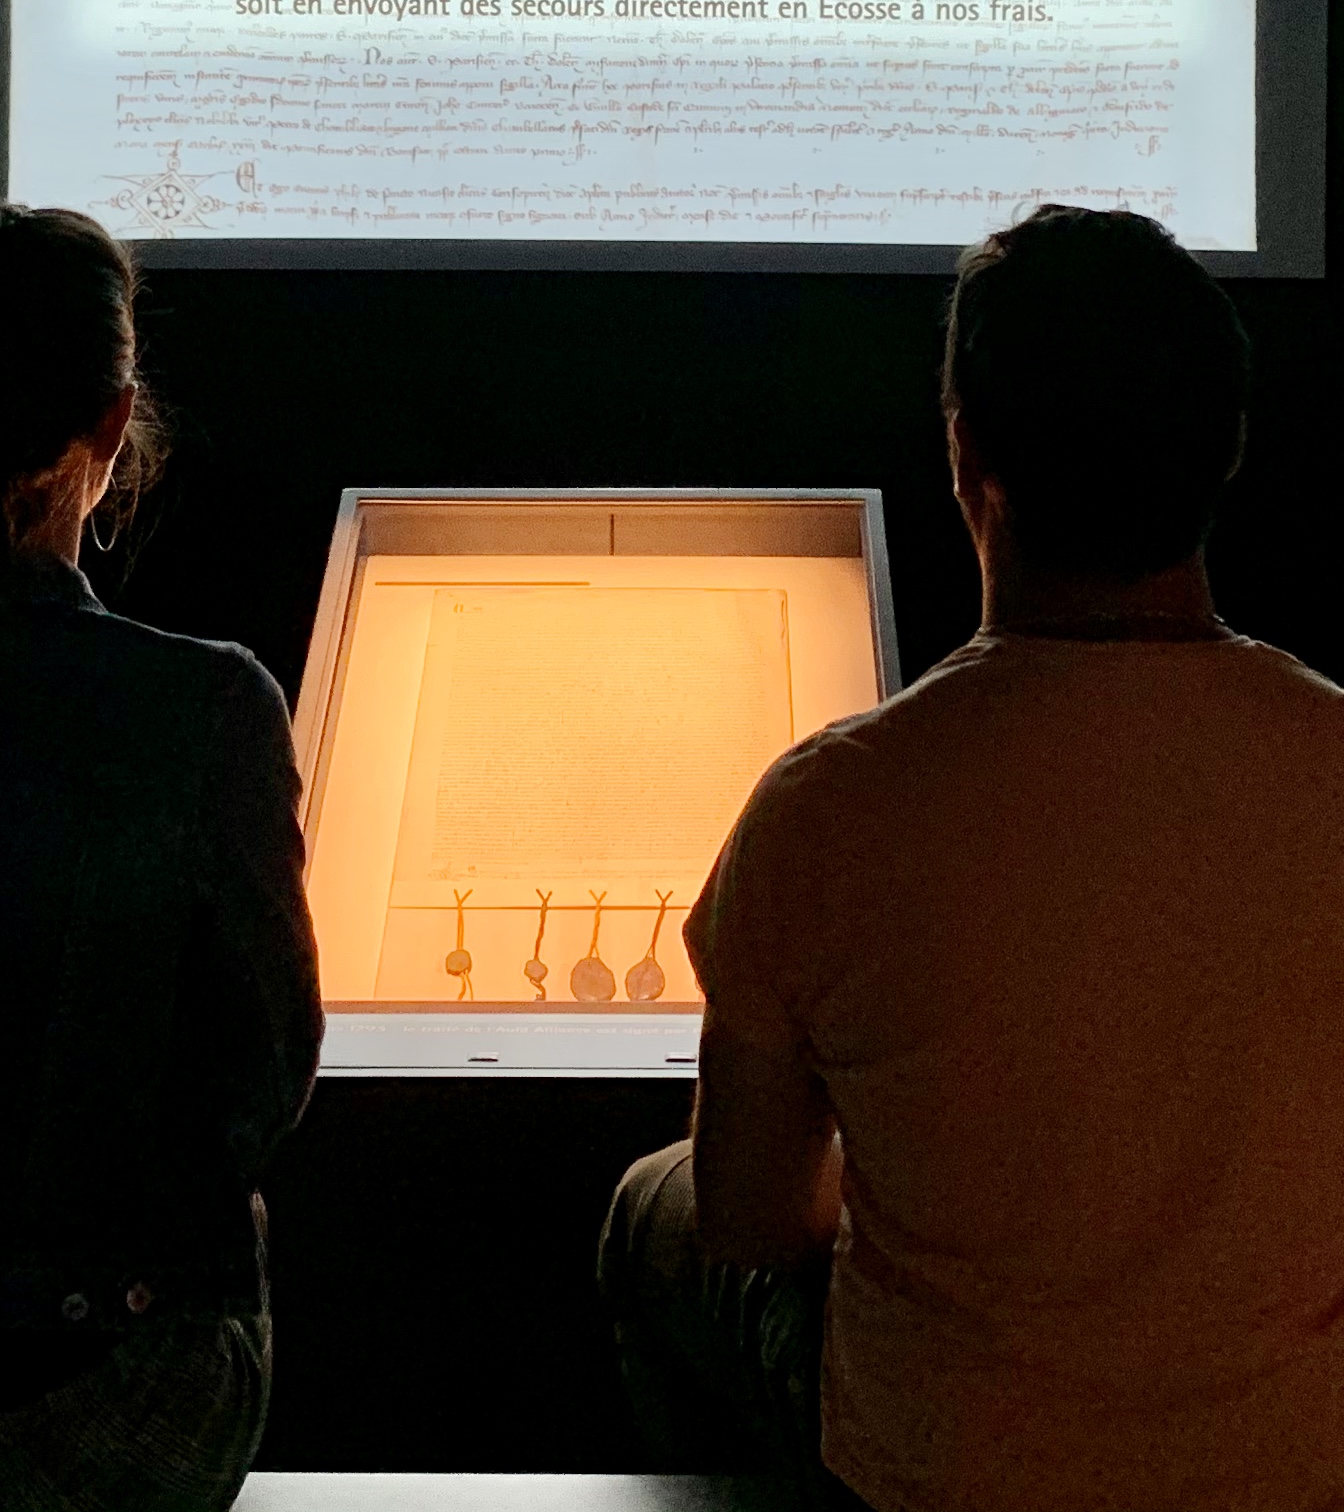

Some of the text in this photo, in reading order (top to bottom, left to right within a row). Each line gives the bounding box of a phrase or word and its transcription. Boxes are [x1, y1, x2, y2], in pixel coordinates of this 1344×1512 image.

[294, 0, 321, 13] en
[512, 0, 603, 15] secours
[780, 2, 806, 17] en
[937, 4, 979, 19] nos
